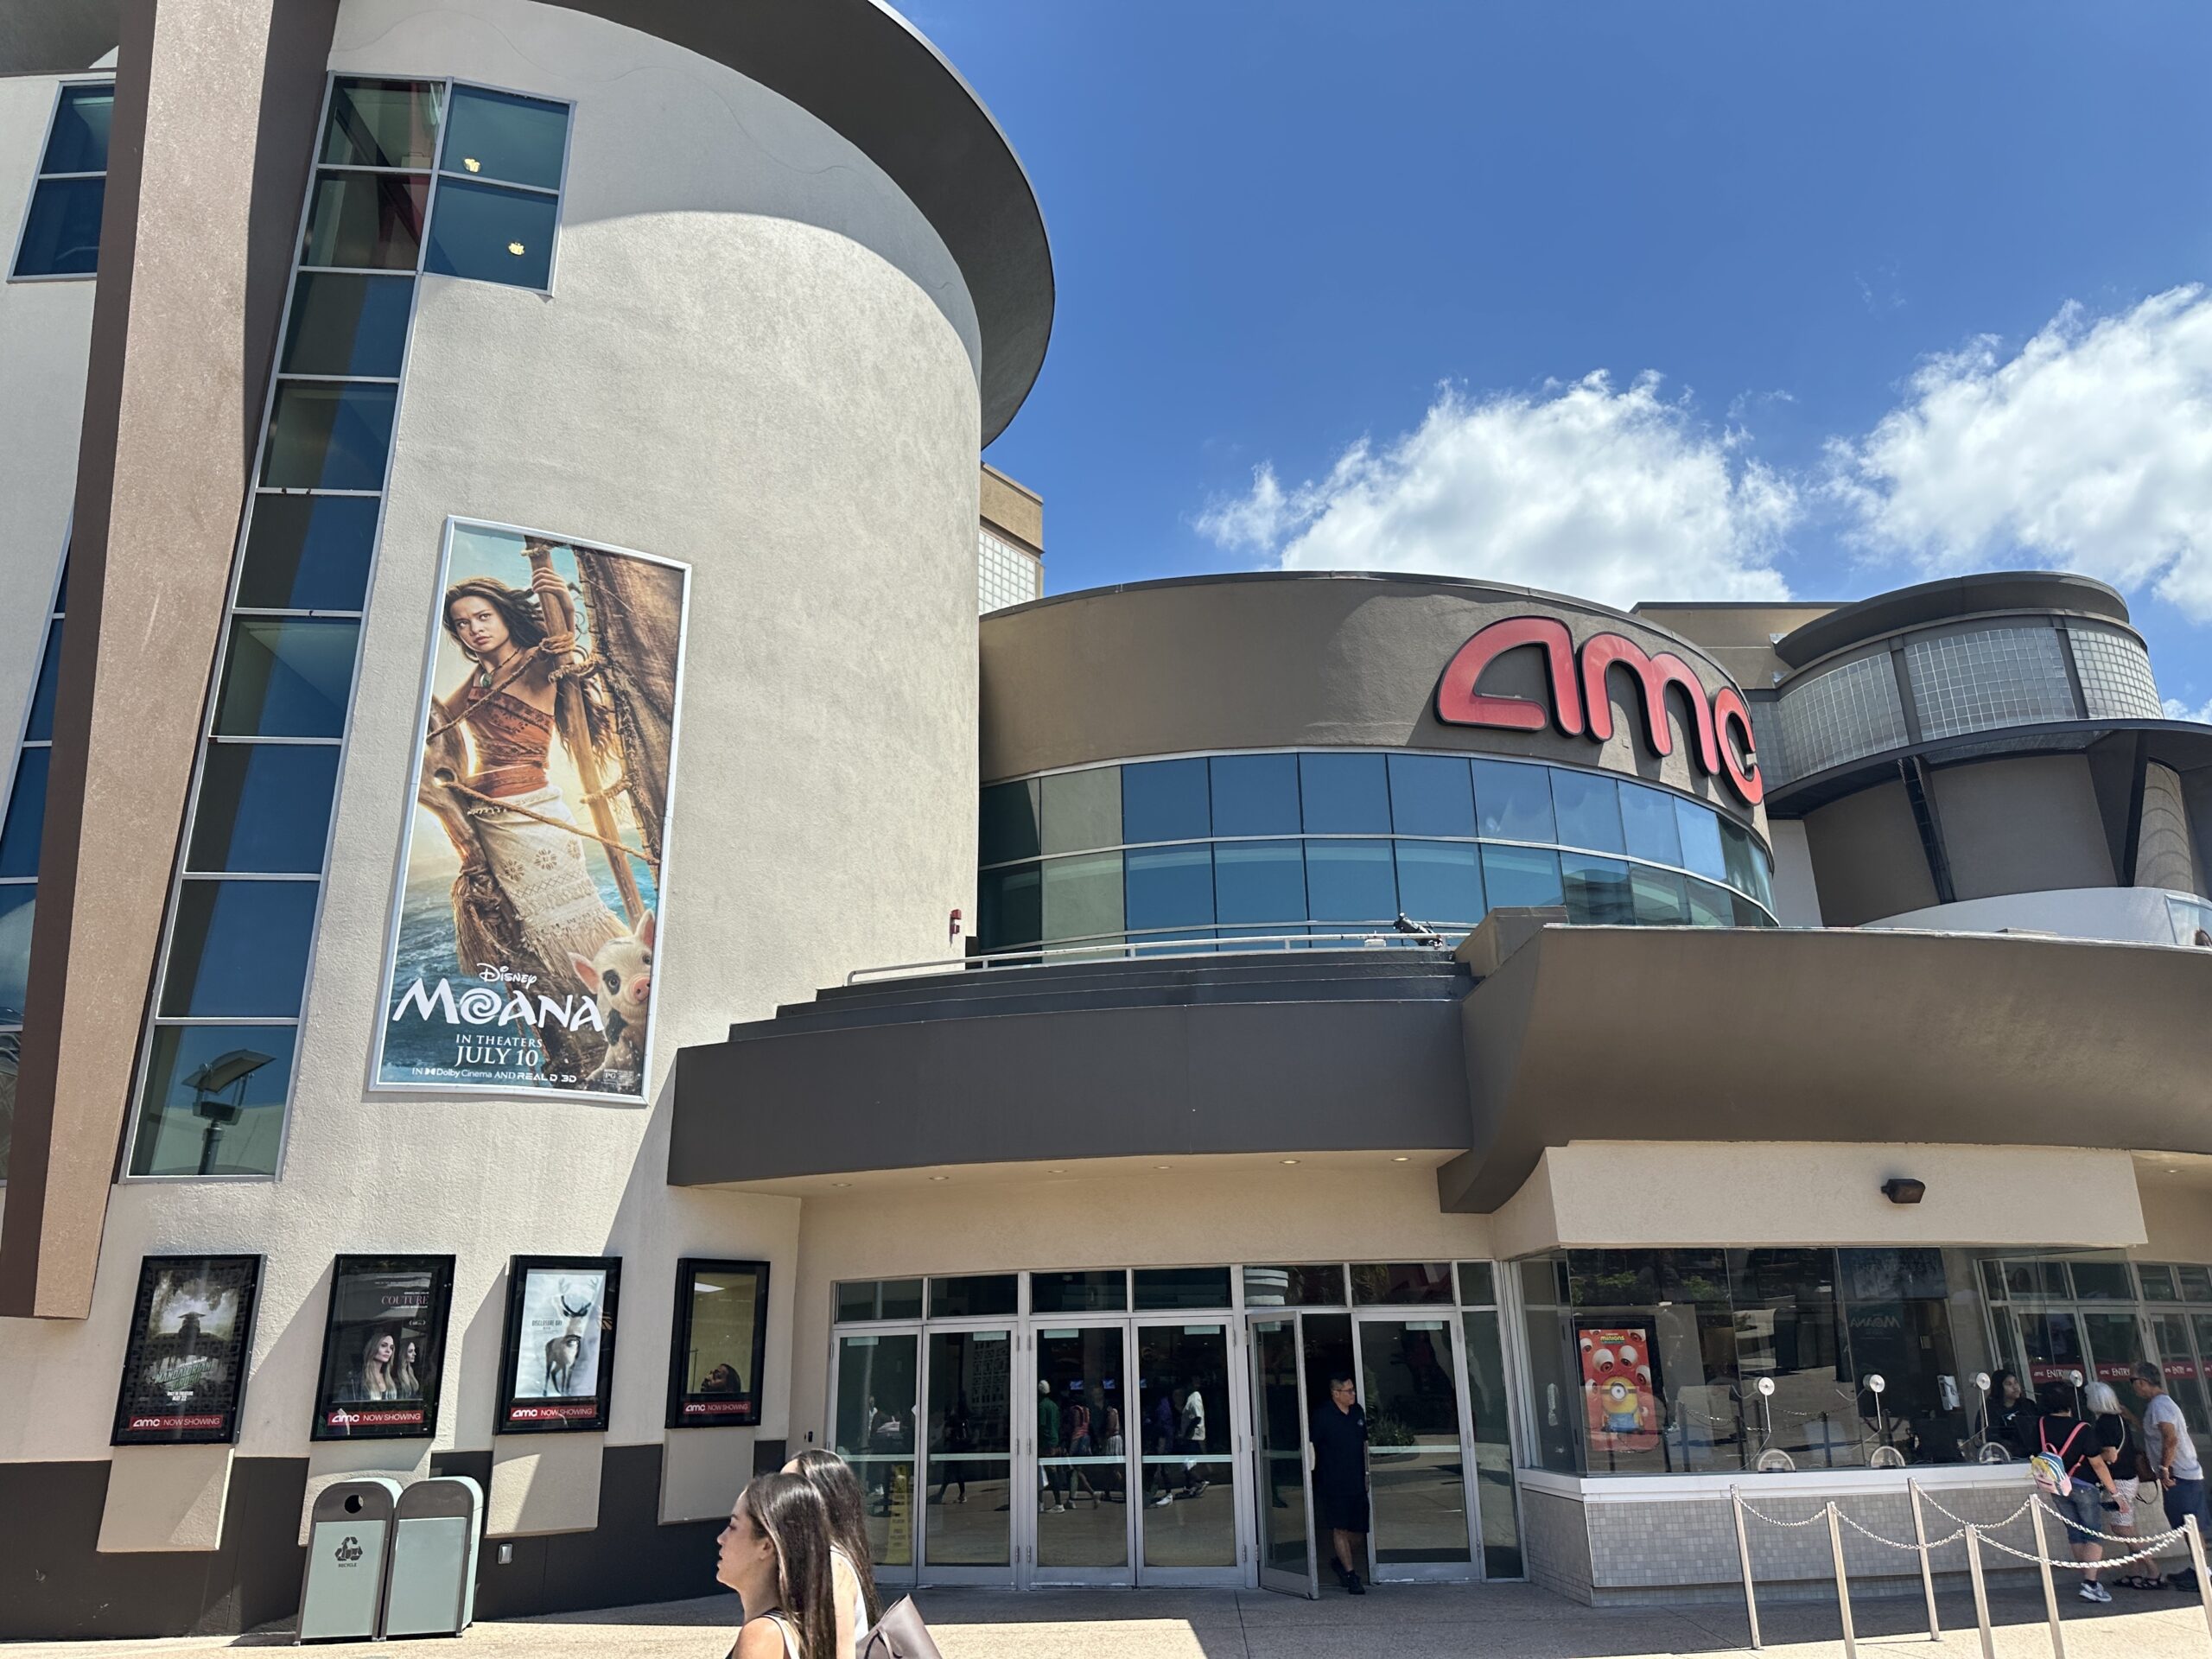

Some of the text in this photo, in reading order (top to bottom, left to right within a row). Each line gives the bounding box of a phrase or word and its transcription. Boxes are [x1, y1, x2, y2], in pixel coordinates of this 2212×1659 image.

[1435, 614, 1764, 806] amc
[477, 963, 537, 988] Disney
[392, 978, 604, 1032] MOANA
[456, 1033, 543, 1047] IN THEATERS
[454, 1046, 538, 1067] JULY 10
[436, 1068, 461, 1077] Dolby
[461, 1069, 493, 1078] Cinema
[493, 1071, 516, 1080] AND
[561, 1074, 577, 1084] 3D
[381, 1295, 429, 1306] COUTURE
[155, 1362, 213, 1383] MANDALORIAN
